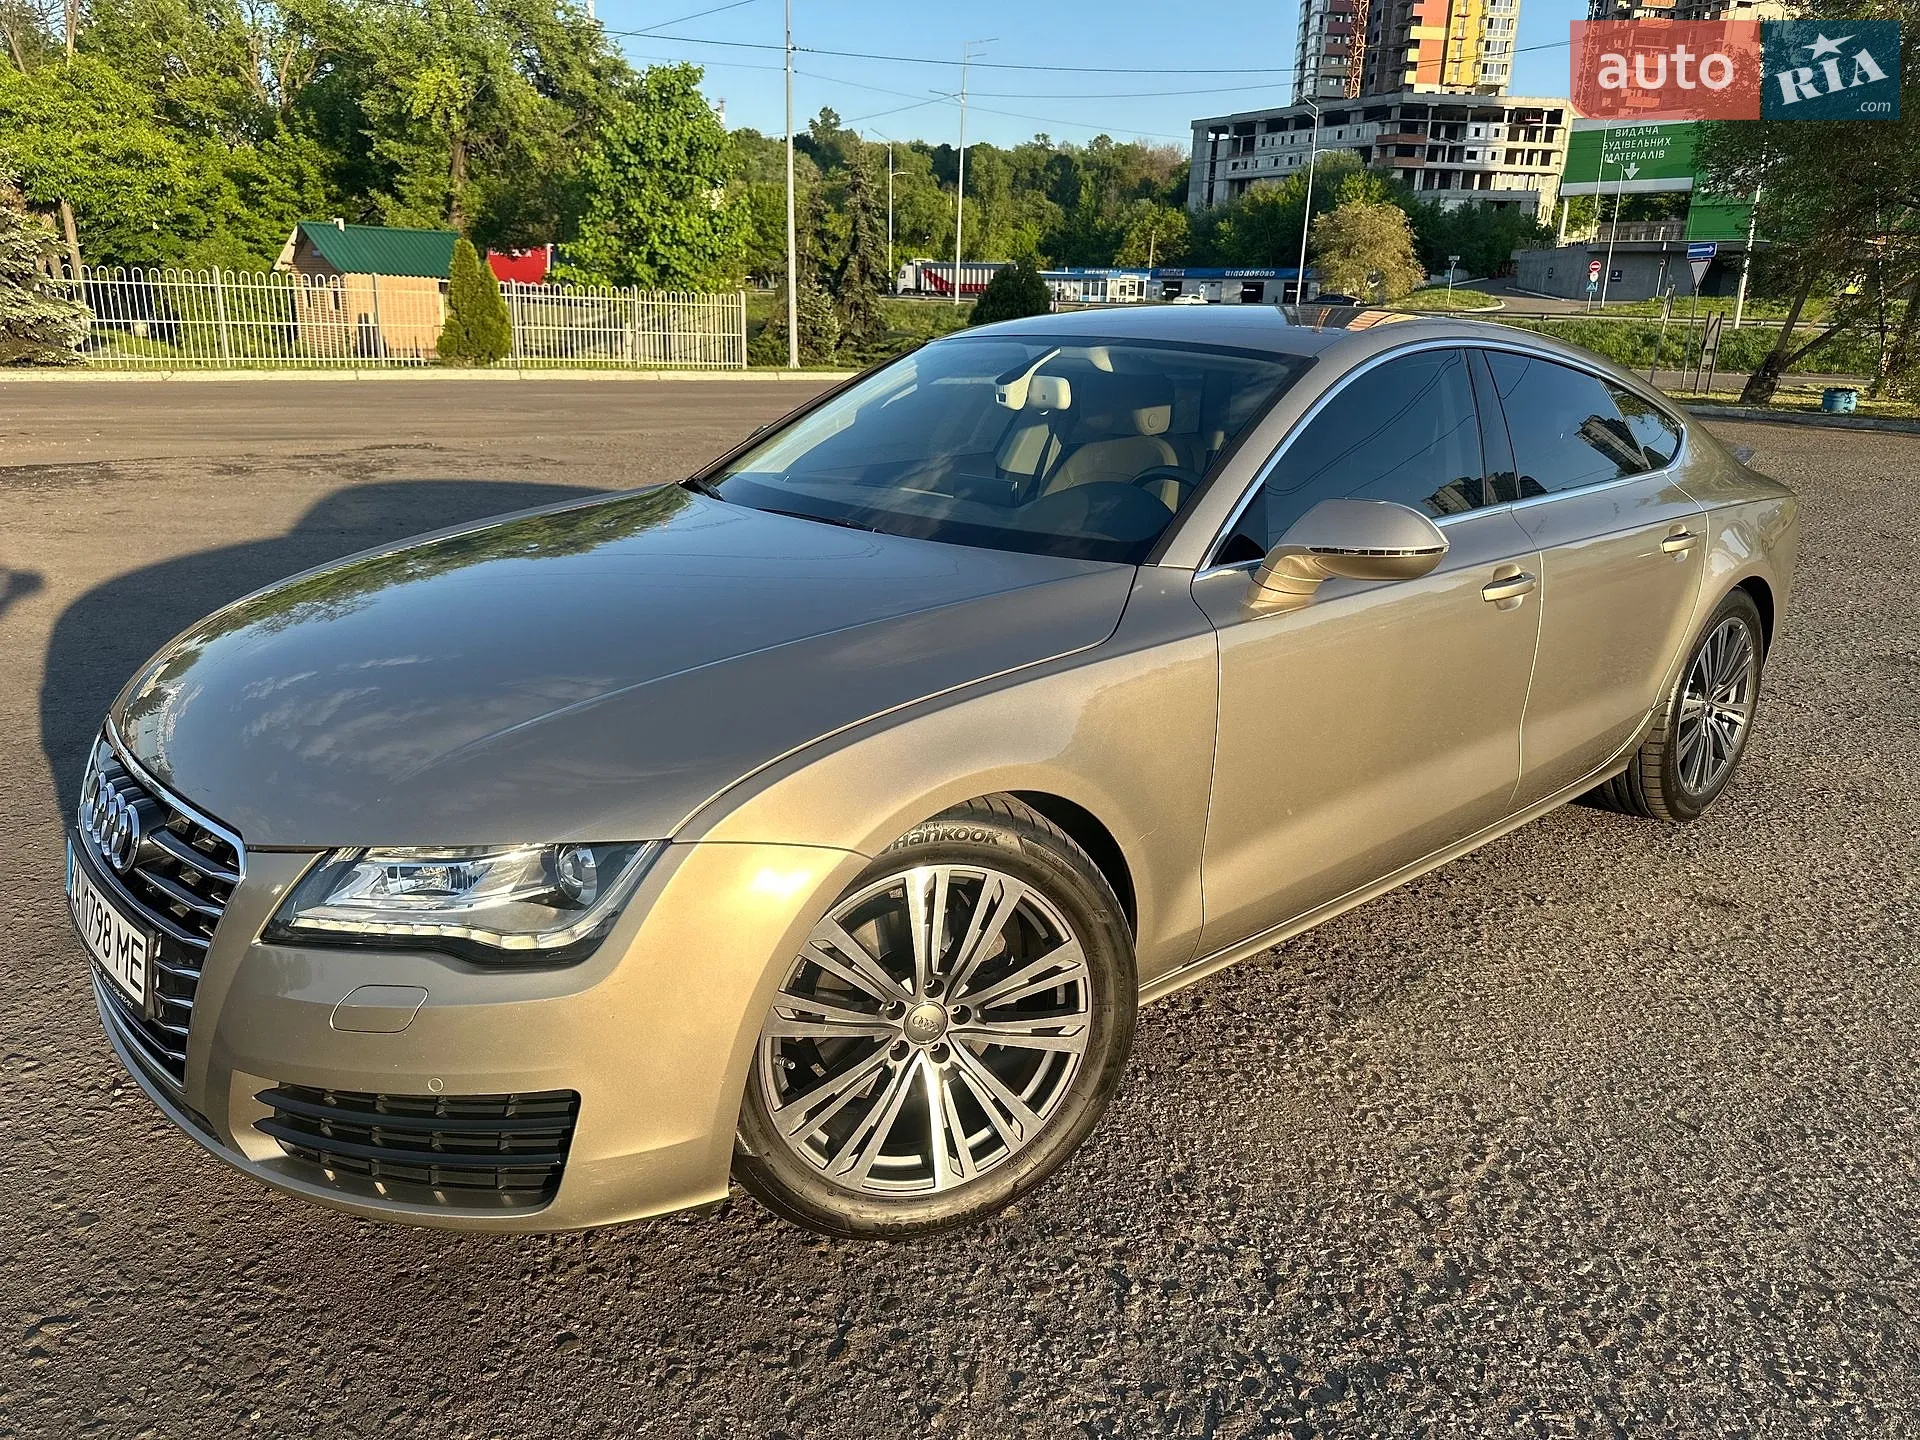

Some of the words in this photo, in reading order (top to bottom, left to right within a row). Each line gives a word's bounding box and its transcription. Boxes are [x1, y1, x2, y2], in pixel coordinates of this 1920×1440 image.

[1615, 126, 1659, 138] ВИДАЧА
[1603, 137, 1672, 151] БУДІВЕЛЬНИХ
[1604, 149, 1665, 162] МАТЕРІАЛІВ
[84, 884, 113, 959] 1798
[116, 920, 144, 994] ME
